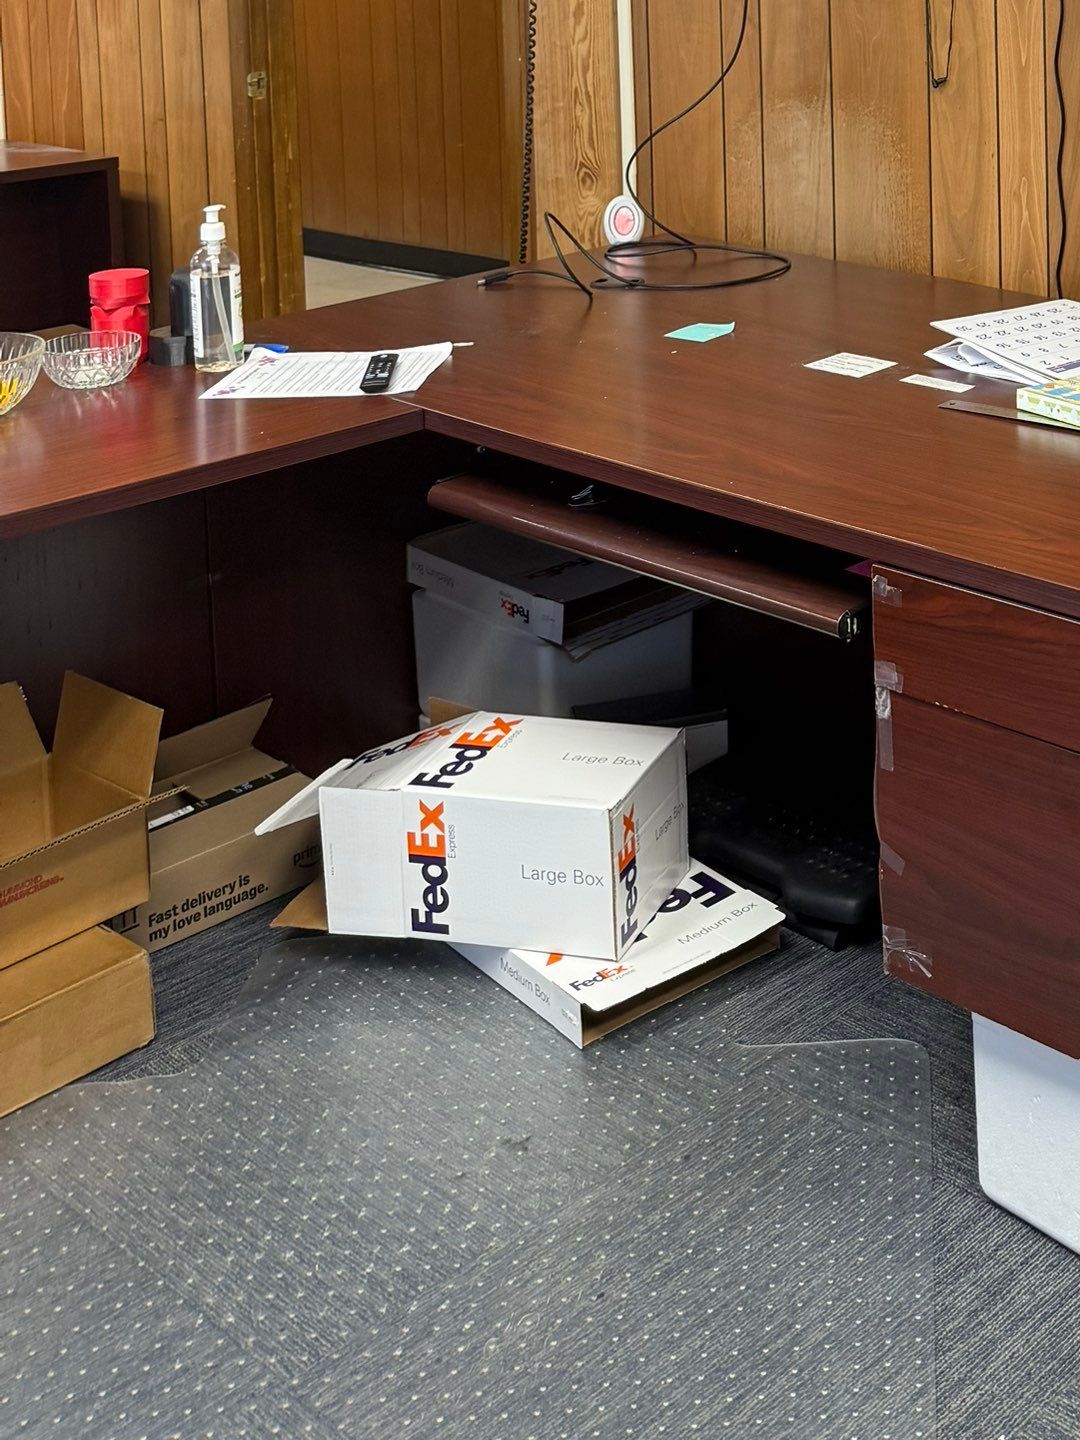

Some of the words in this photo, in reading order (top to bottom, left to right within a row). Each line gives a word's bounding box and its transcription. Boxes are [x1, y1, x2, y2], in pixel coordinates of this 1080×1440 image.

[500, 597, 530, 625] FedEx
[407, 717, 524, 789] FedEx
[562, 752, 608, 765] Large
[612, 756, 645, 767] Box
[447, 824, 456, 859] Express
[407, 799, 450, 935] FedEx
[521, 864, 567, 886] Large
[573, 869, 605, 887] Box
[617, 802, 638, 948] FedEx
[148, 907, 180, 928] Fast
[181, 879, 237, 913] delivery
[238, 874, 251, 888] is
[149, 922, 172, 942] my
[173, 912, 202, 933] love
[203, 883, 269, 919] language.
[677, 915, 732, 946] Medium
[731, 902, 759, 918] Box
[500, 957, 534, 991] Medium
[535, 984, 551, 1004] Box
[569, 963, 627, 992] FedEx
